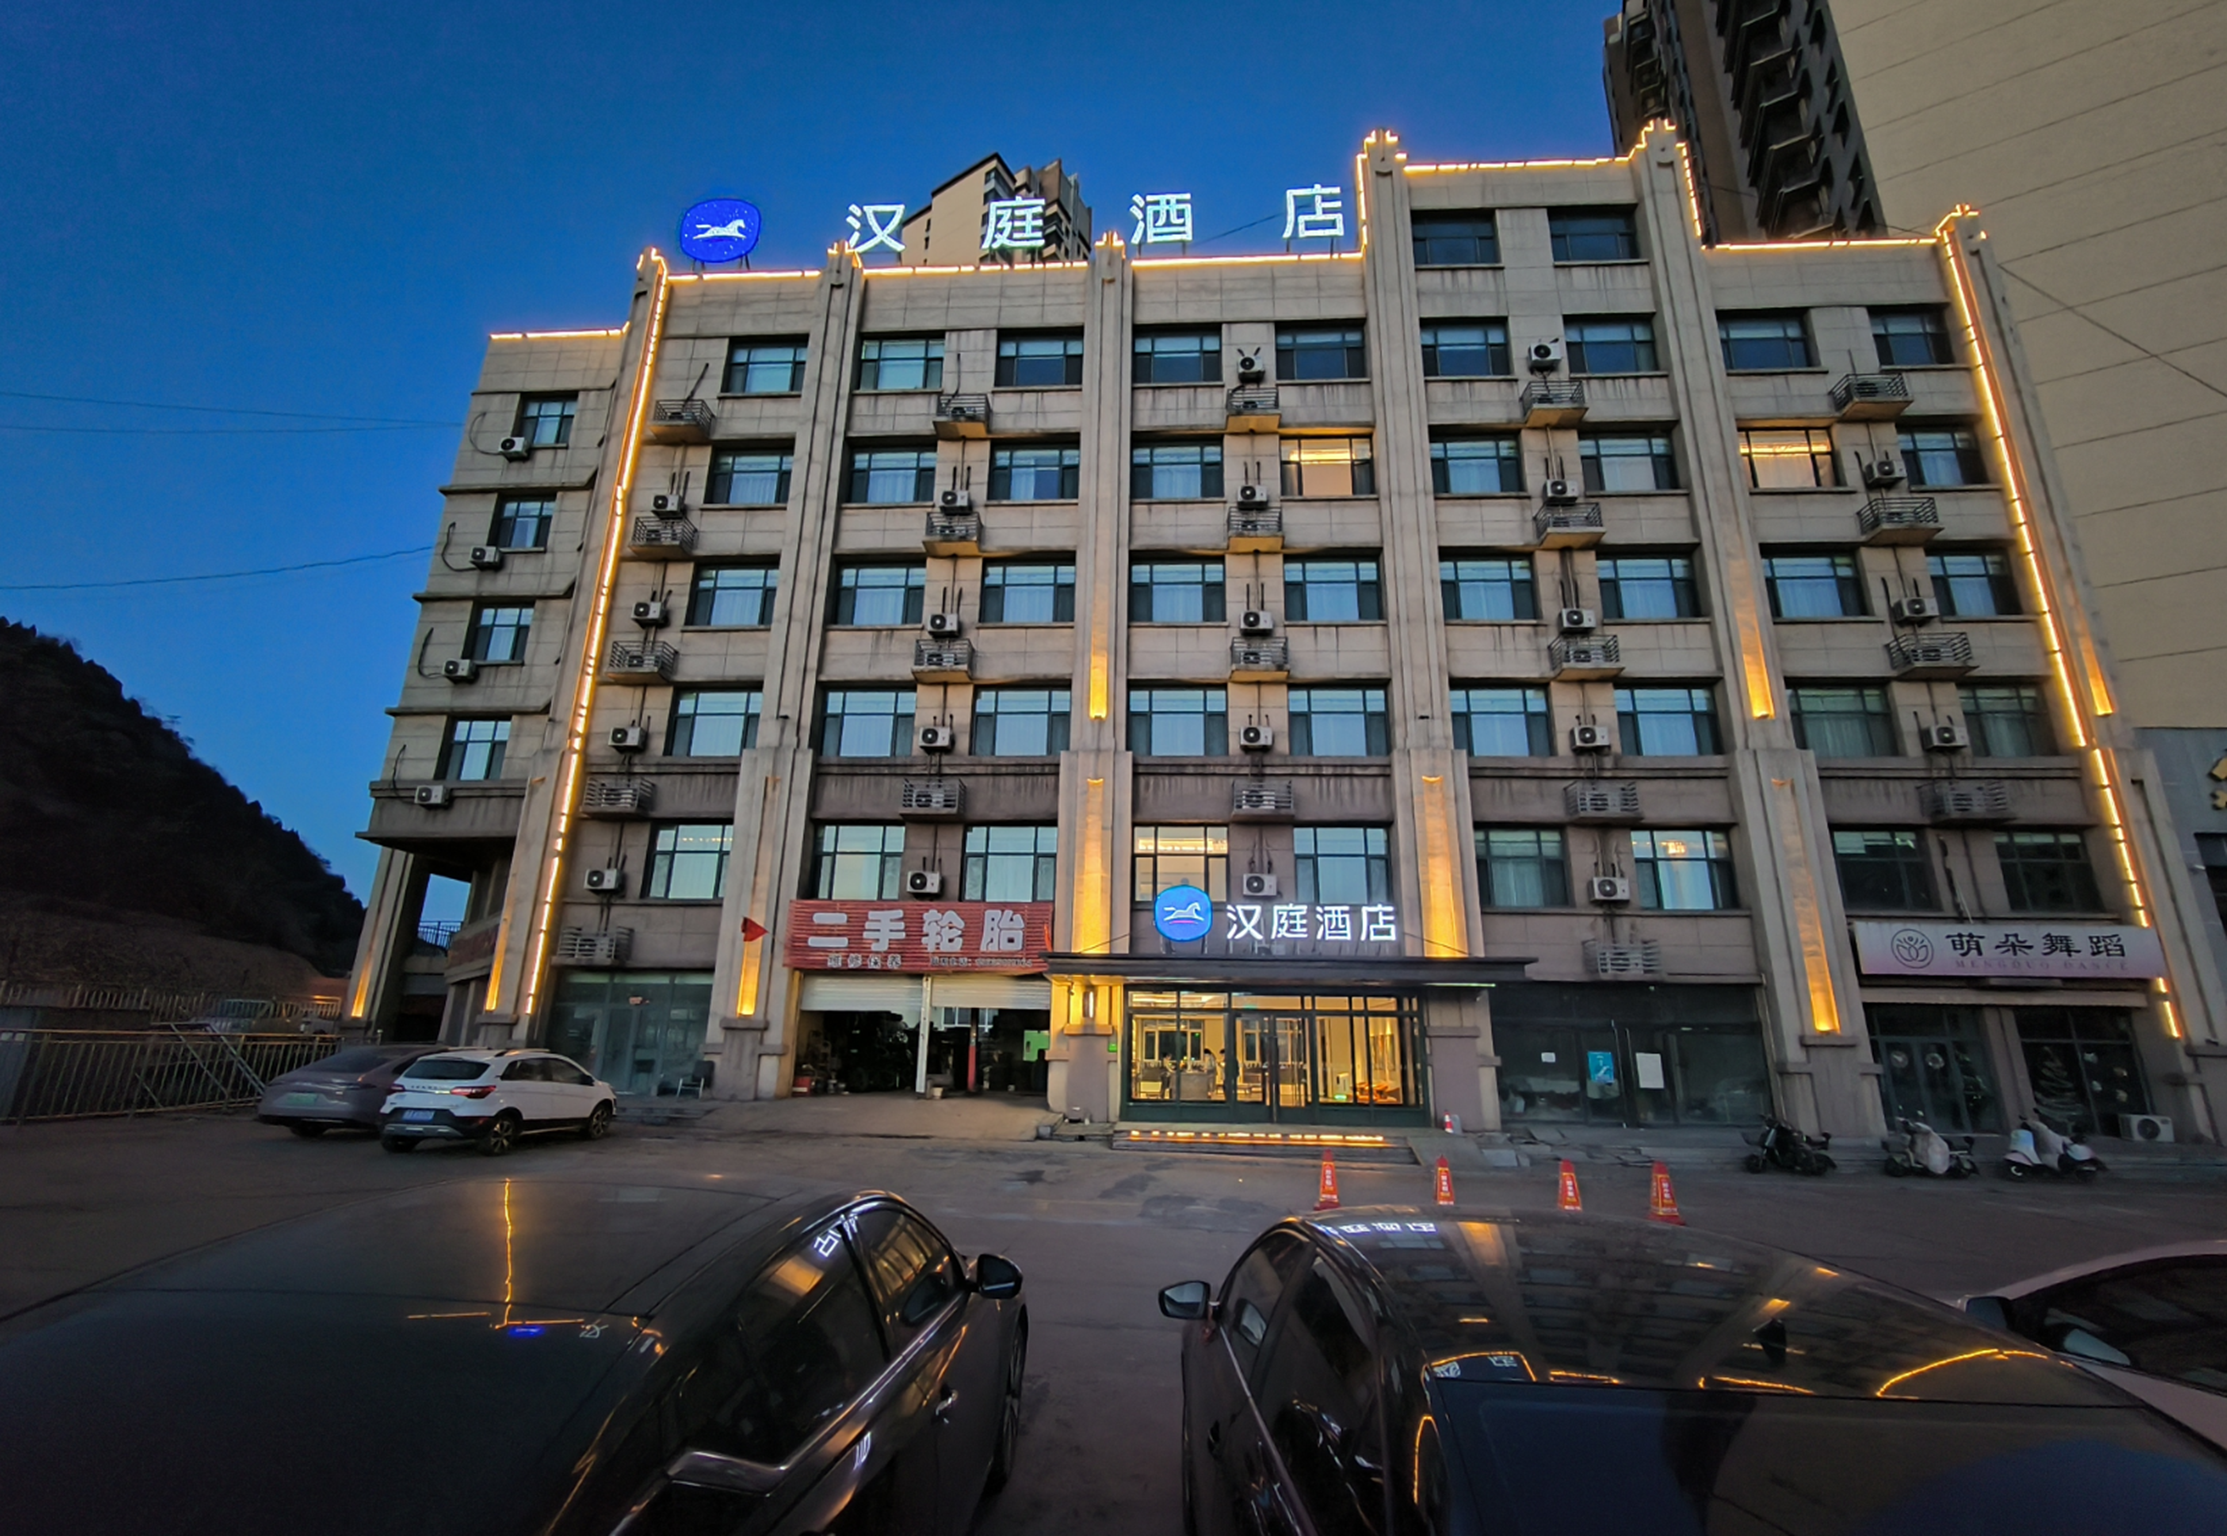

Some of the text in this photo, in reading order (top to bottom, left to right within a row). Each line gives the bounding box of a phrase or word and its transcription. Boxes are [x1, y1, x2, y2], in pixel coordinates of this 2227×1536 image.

[845, 183, 1346, 253] 汉庭酒店
[807, 908, 1026, 953] 二手轮胎
[1226, 903, 1398, 942] 汉庭酒店
[1945, 932, 2126, 958] 萌朵舞蹈
[1955, 959, 2129, 971] MENGDUO DANCE
